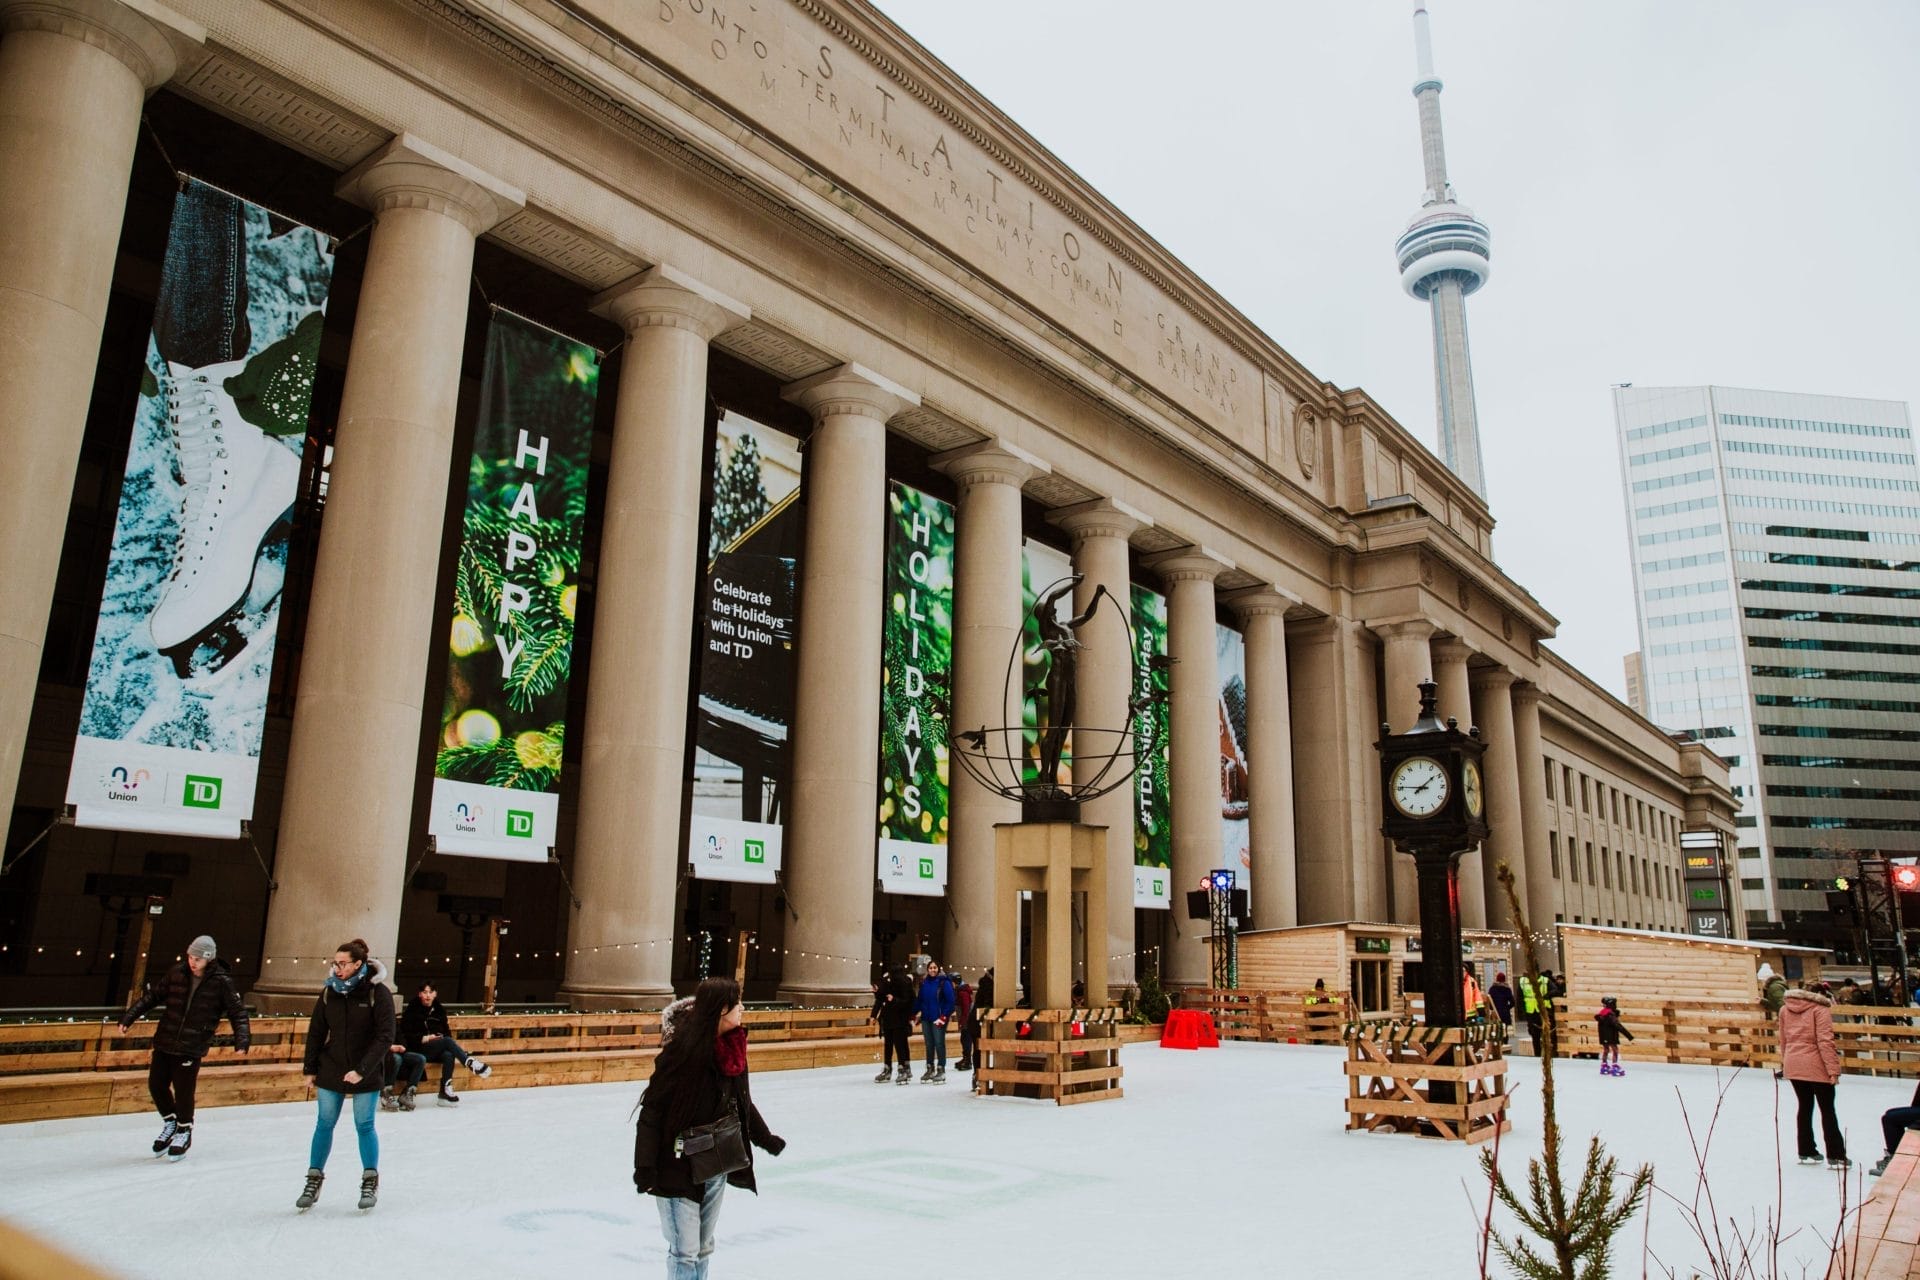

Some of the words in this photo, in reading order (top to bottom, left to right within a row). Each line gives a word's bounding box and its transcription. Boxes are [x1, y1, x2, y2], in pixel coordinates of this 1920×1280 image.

[816, 45, 1123, 297] STATION
[796, 68, 931, 178] TERMINALS
[949, 180, 1034, 250] RAILWAY
[1050, 254, 1122, 315] COMPANY
[1156, 313, 1237, 383] GRAND
[1157, 350, 1240, 419] RAILWAY
[493, 428, 550, 680] HAPPY
[713, 577, 772, 606] Celebrate
[712, 598, 730, 615] the
[732, 603, 784, 630] Holidays
[710, 618, 735, 636] with
[737, 623, 772, 646] Union
[709, 638, 730, 655] and
[732, 642, 753, 659] TD
[902, 511, 931, 819] HOLIDAYS
[108, 791, 138, 802] Union
[187, 780, 218, 803] TD
[455, 824, 476, 833] Union
[509, 814, 531, 833] TD
[745, 843, 763, 859] TD
[1698, 917, 1717, 929] UP
